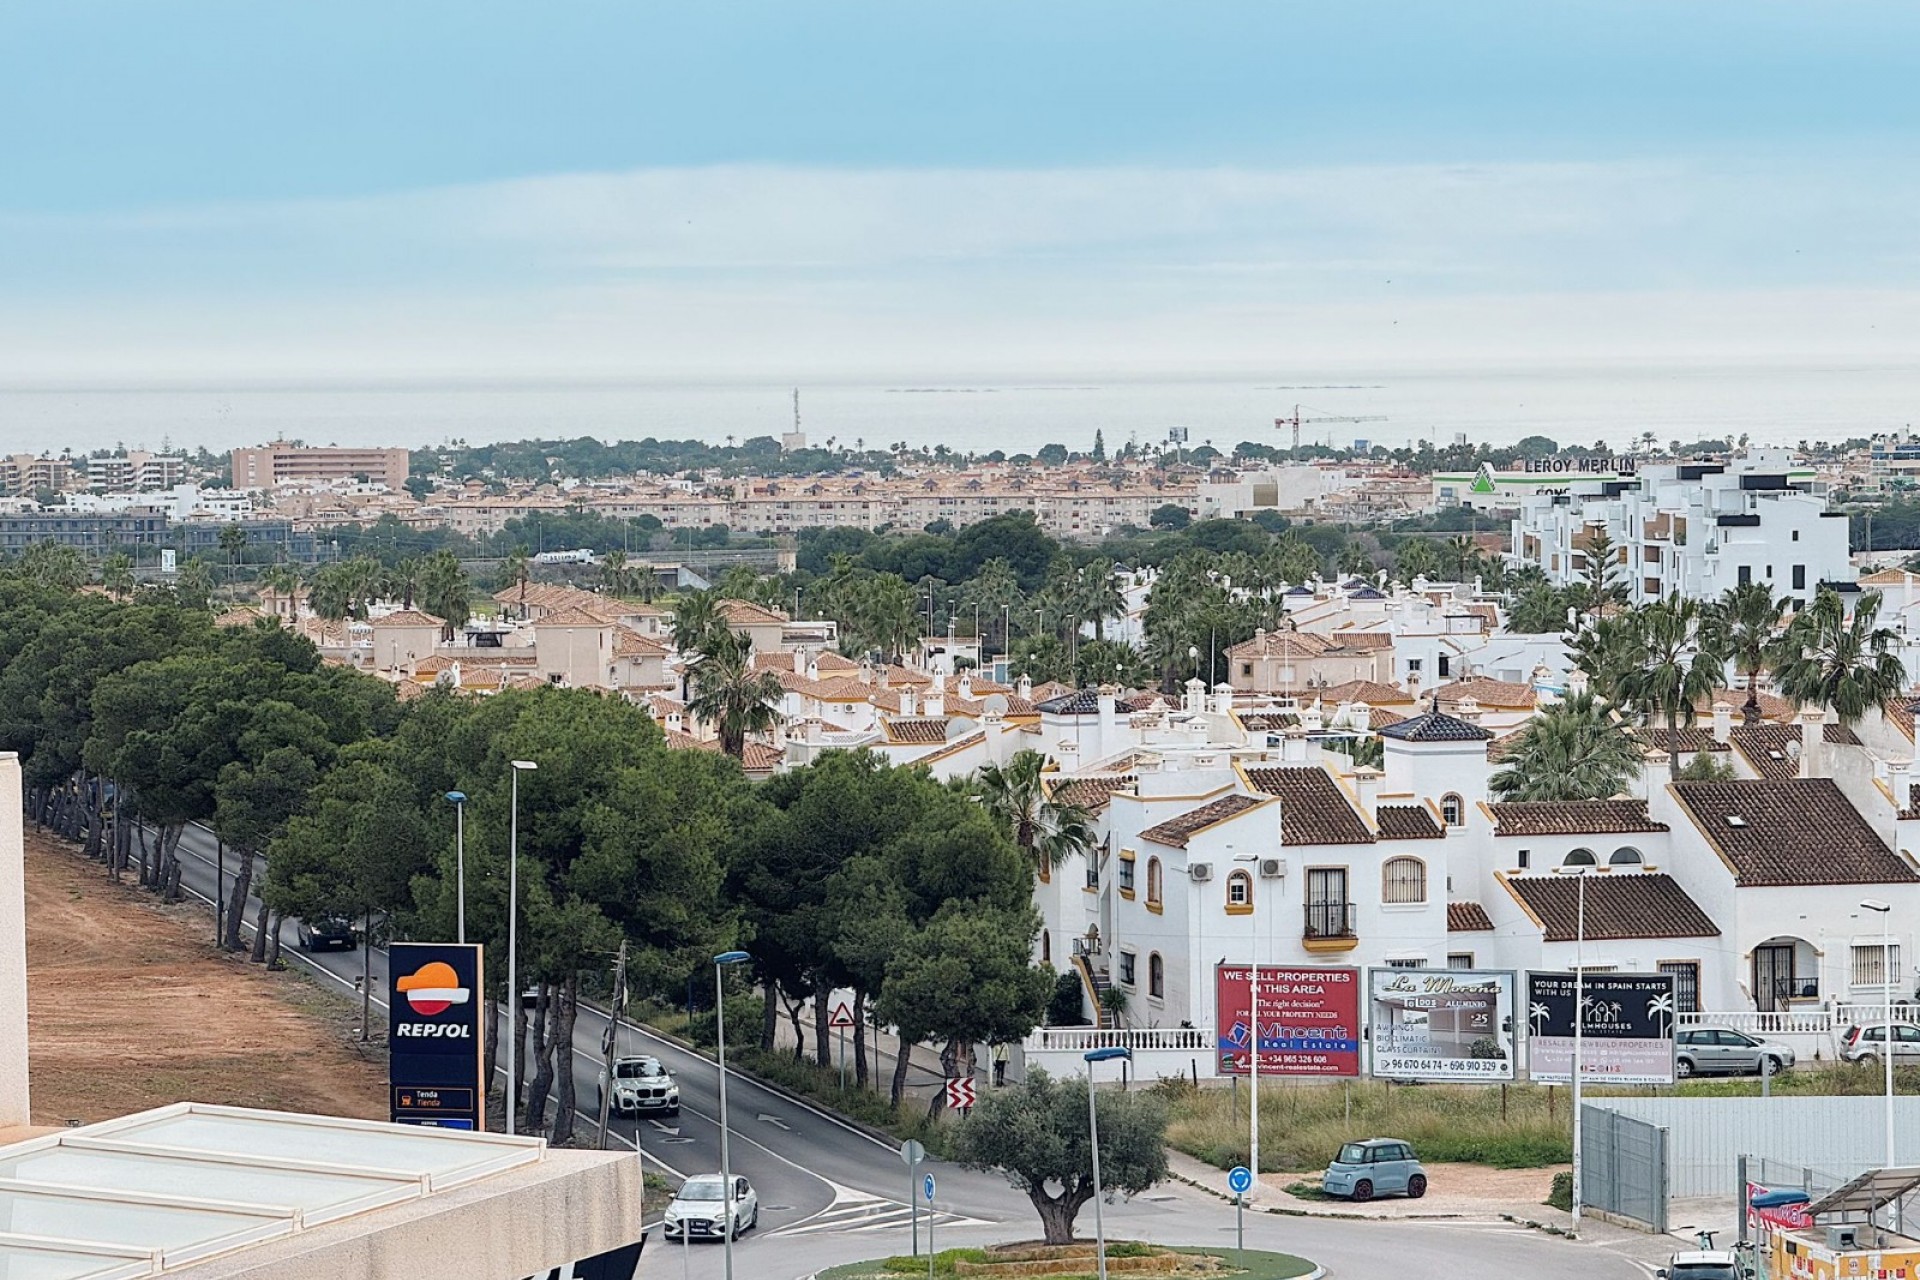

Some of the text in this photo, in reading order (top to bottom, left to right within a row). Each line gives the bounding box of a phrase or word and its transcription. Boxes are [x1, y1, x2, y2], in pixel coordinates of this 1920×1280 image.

[1524, 458, 1635, 473] LEROY MERLIN
[1223, 971, 1350, 982] WE SELL PROPERTIES
[1264, 984, 1290, 993] THIS
[1292, 985, 1325, 994] AREA
[1382, 976, 1503, 994] La Morena
[1534, 980, 1559, 989] YOUR
[1607, 982, 1633, 990] SPAIN
[1635, 982, 1667, 990] STARTS
[1534, 988, 1558, 996] WITH
[1273, 1000, 1289, 1009] right
[1445, 1000, 1487, 1008] ALUMINIO
[1263, 1010, 1281, 1018] YOUR
[1314, 1011, 1338, 1019] NEEDS
[397, 1023, 471, 1038] REPSOL
[1257, 1021, 1348, 1040] Vincent
[1376, 1024, 1415, 1032] AWNINGS
[1570, 1022, 1632, 1030] PLMHOUSES
[1376, 1034, 1427, 1042] BIOCLIMATIC
[1264, 1040, 1346, 1049] Real Estate
[1618, 1041, 1664, 1049] PROPERTIES
[1376, 1045, 1442, 1054] GLASS CURTAINS
[1392, 1060, 1402, 1069] 96
[1404, 1060, 1419, 1069] 670
[1421, 1060, 1432, 1069] 64
[1433, 1060, 1442, 1070] 74
[1450, 1061, 1465, 1070] 696
[1467, 1061, 1480, 1071] 910
[1482, 1061, 1496, 1071] 329
[416, 1090, 438, 1098] Tenda
[417, 1099, 441, 1107] Tienda
